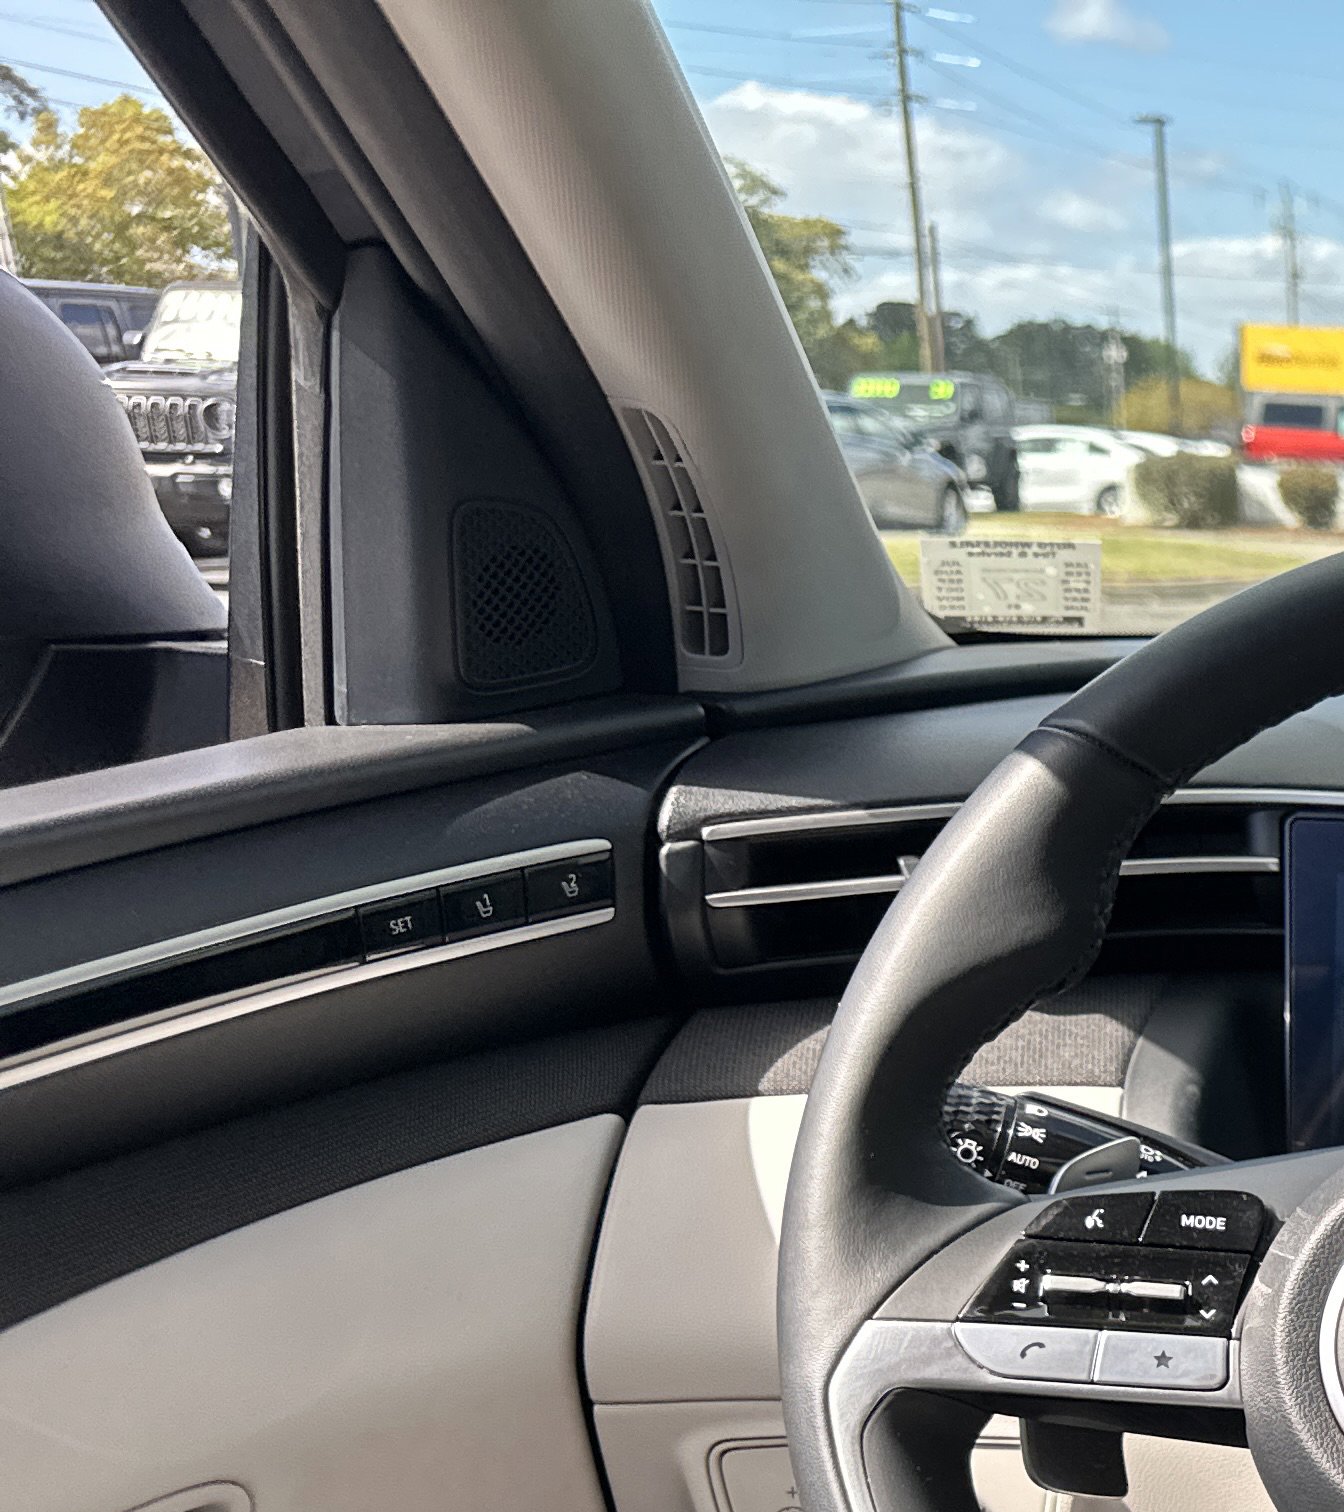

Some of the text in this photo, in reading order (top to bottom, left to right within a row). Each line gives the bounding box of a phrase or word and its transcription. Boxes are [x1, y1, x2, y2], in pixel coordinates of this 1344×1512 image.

[390, 916, 412, 935] SET
[1008, 1152, 1039, 1169] AUTO
[1181, 1214, 1226, 1230] MODE
